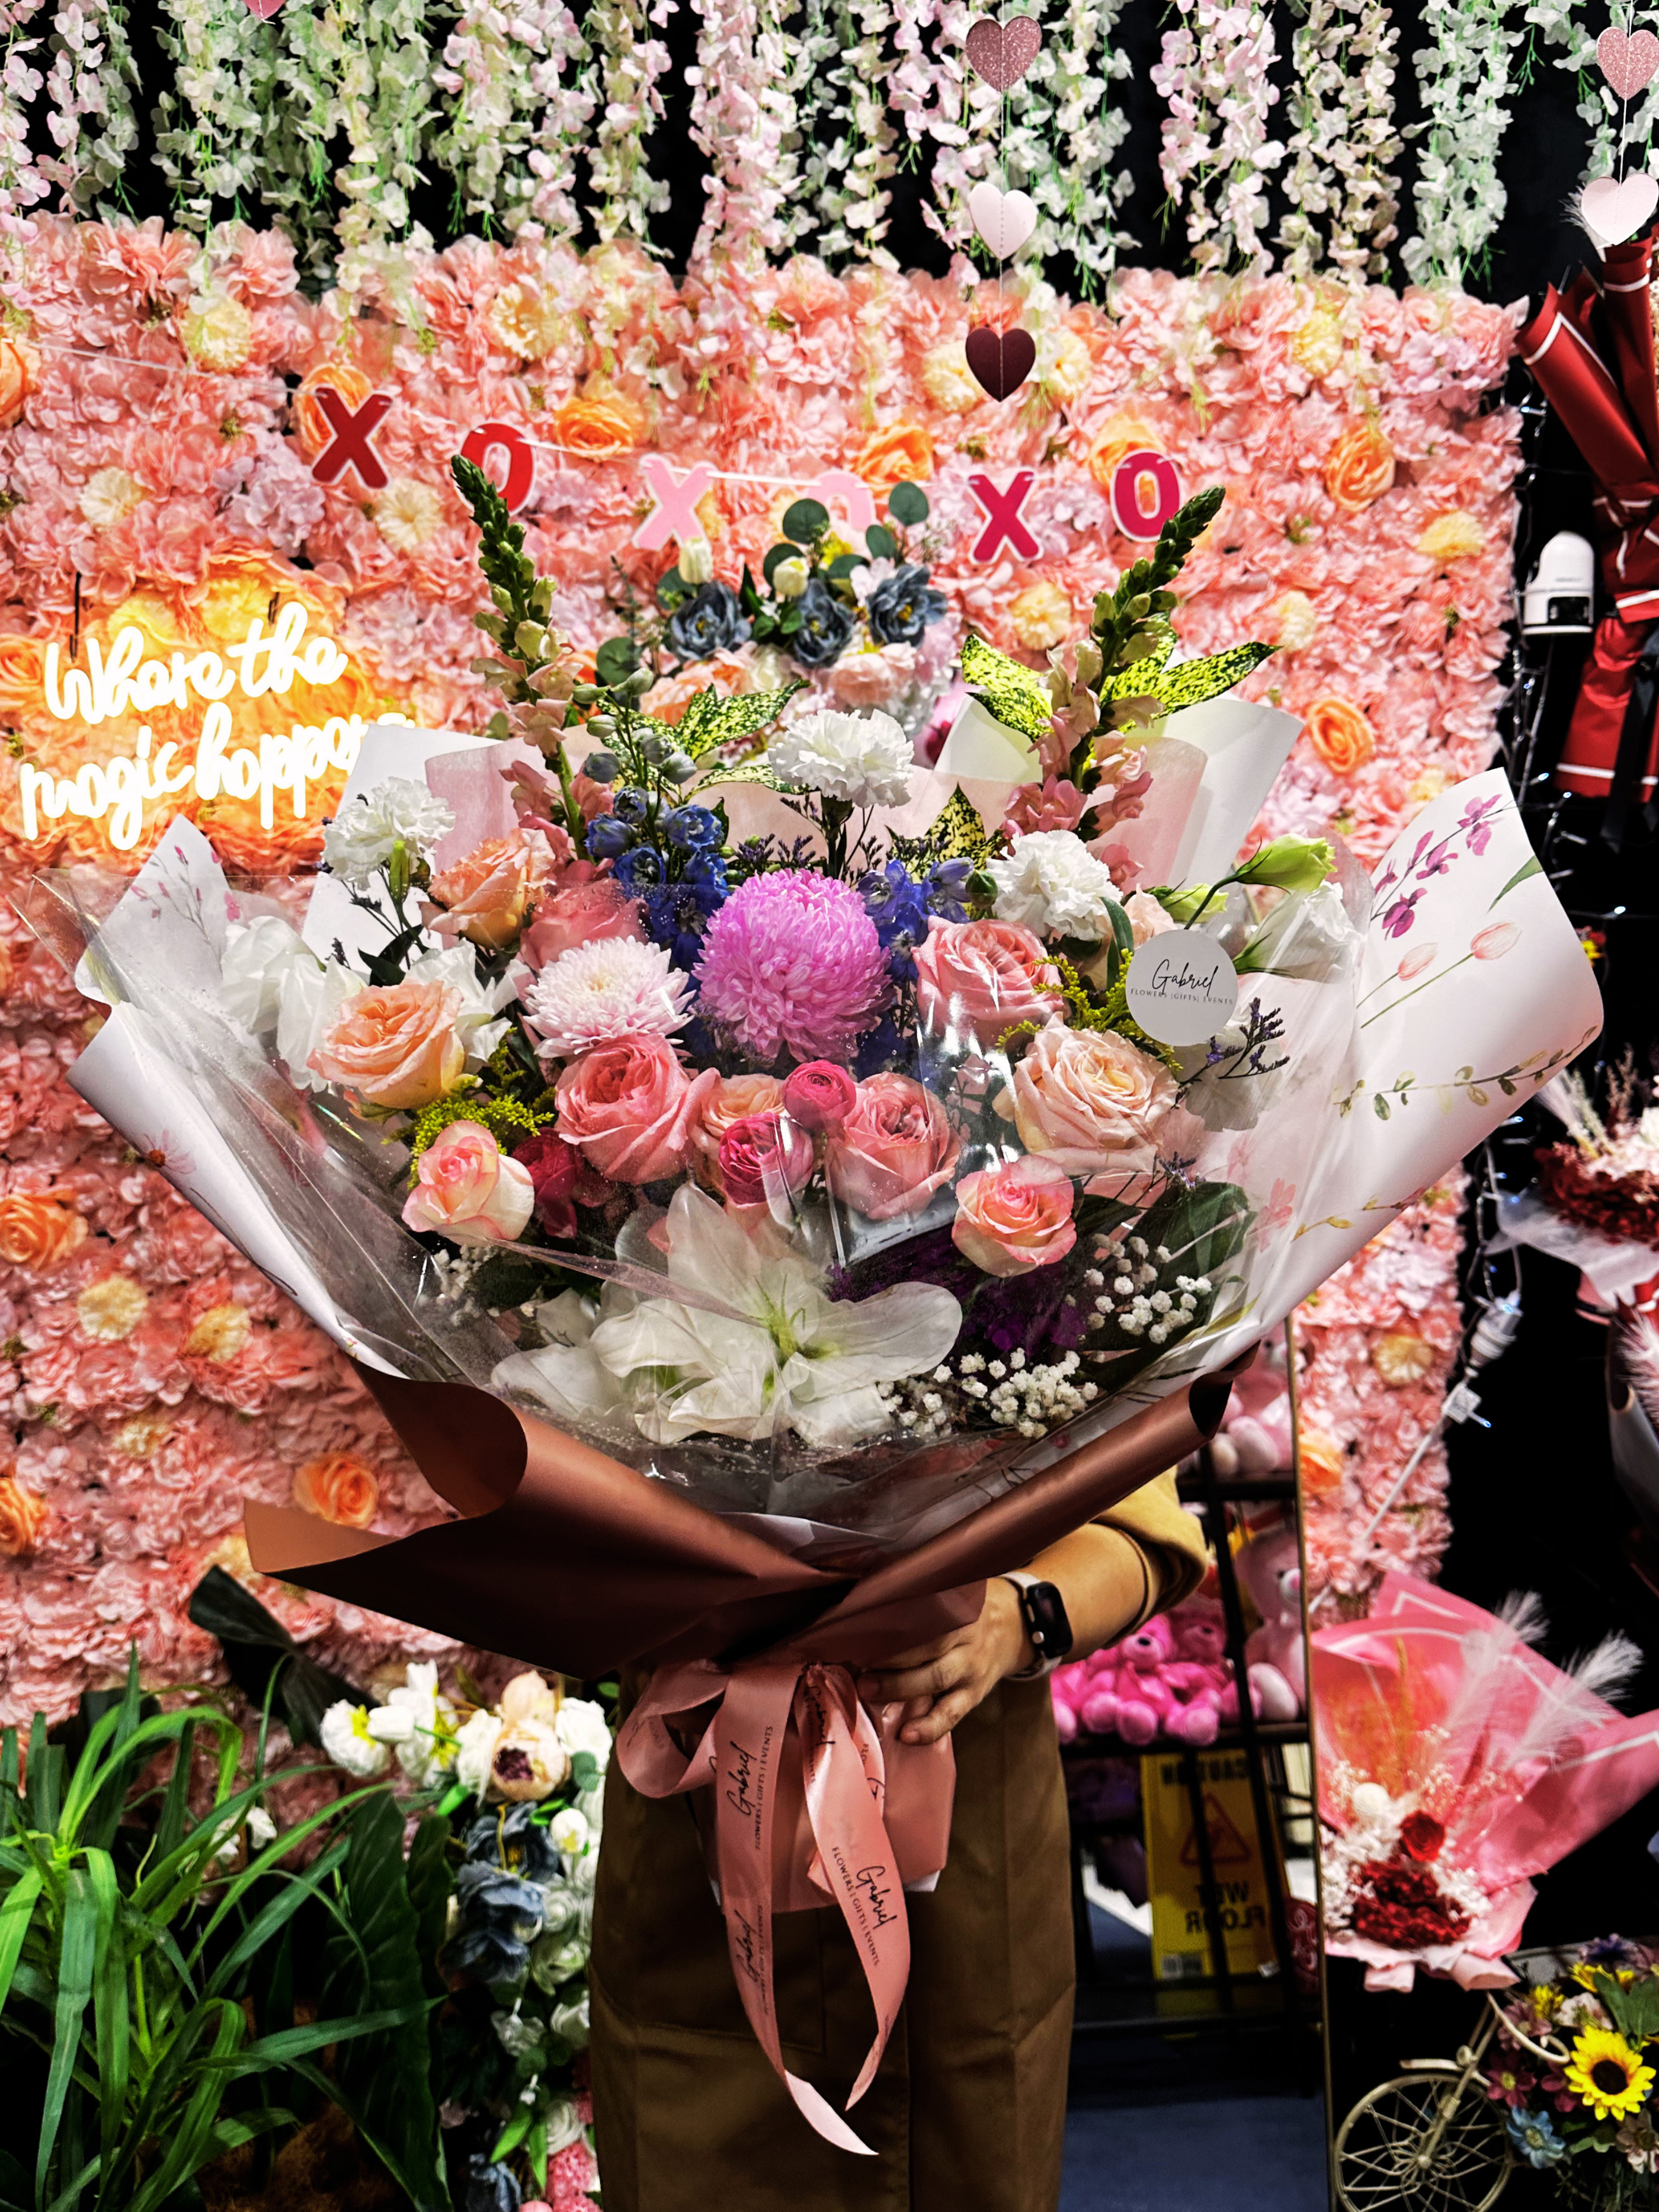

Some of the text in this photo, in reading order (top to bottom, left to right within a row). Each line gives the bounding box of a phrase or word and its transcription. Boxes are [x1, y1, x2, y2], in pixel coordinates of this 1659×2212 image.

[44, 601, 348, 724] Where the
[20, 725, 196, 851] magic
[1130, 988, 1167, 998] FLOWERS
[1203, 996, 1233, 1004] EVENTS
[1152, 959, 1219, 997] Gabriel
[726, 1740, 757, 1816] Gabriel
[832, 1846, 854, 1893] FLOWERS
[864, 1931, 880, 1966] EVENTS
[856, 1865, 898, 1930] Gabriel
